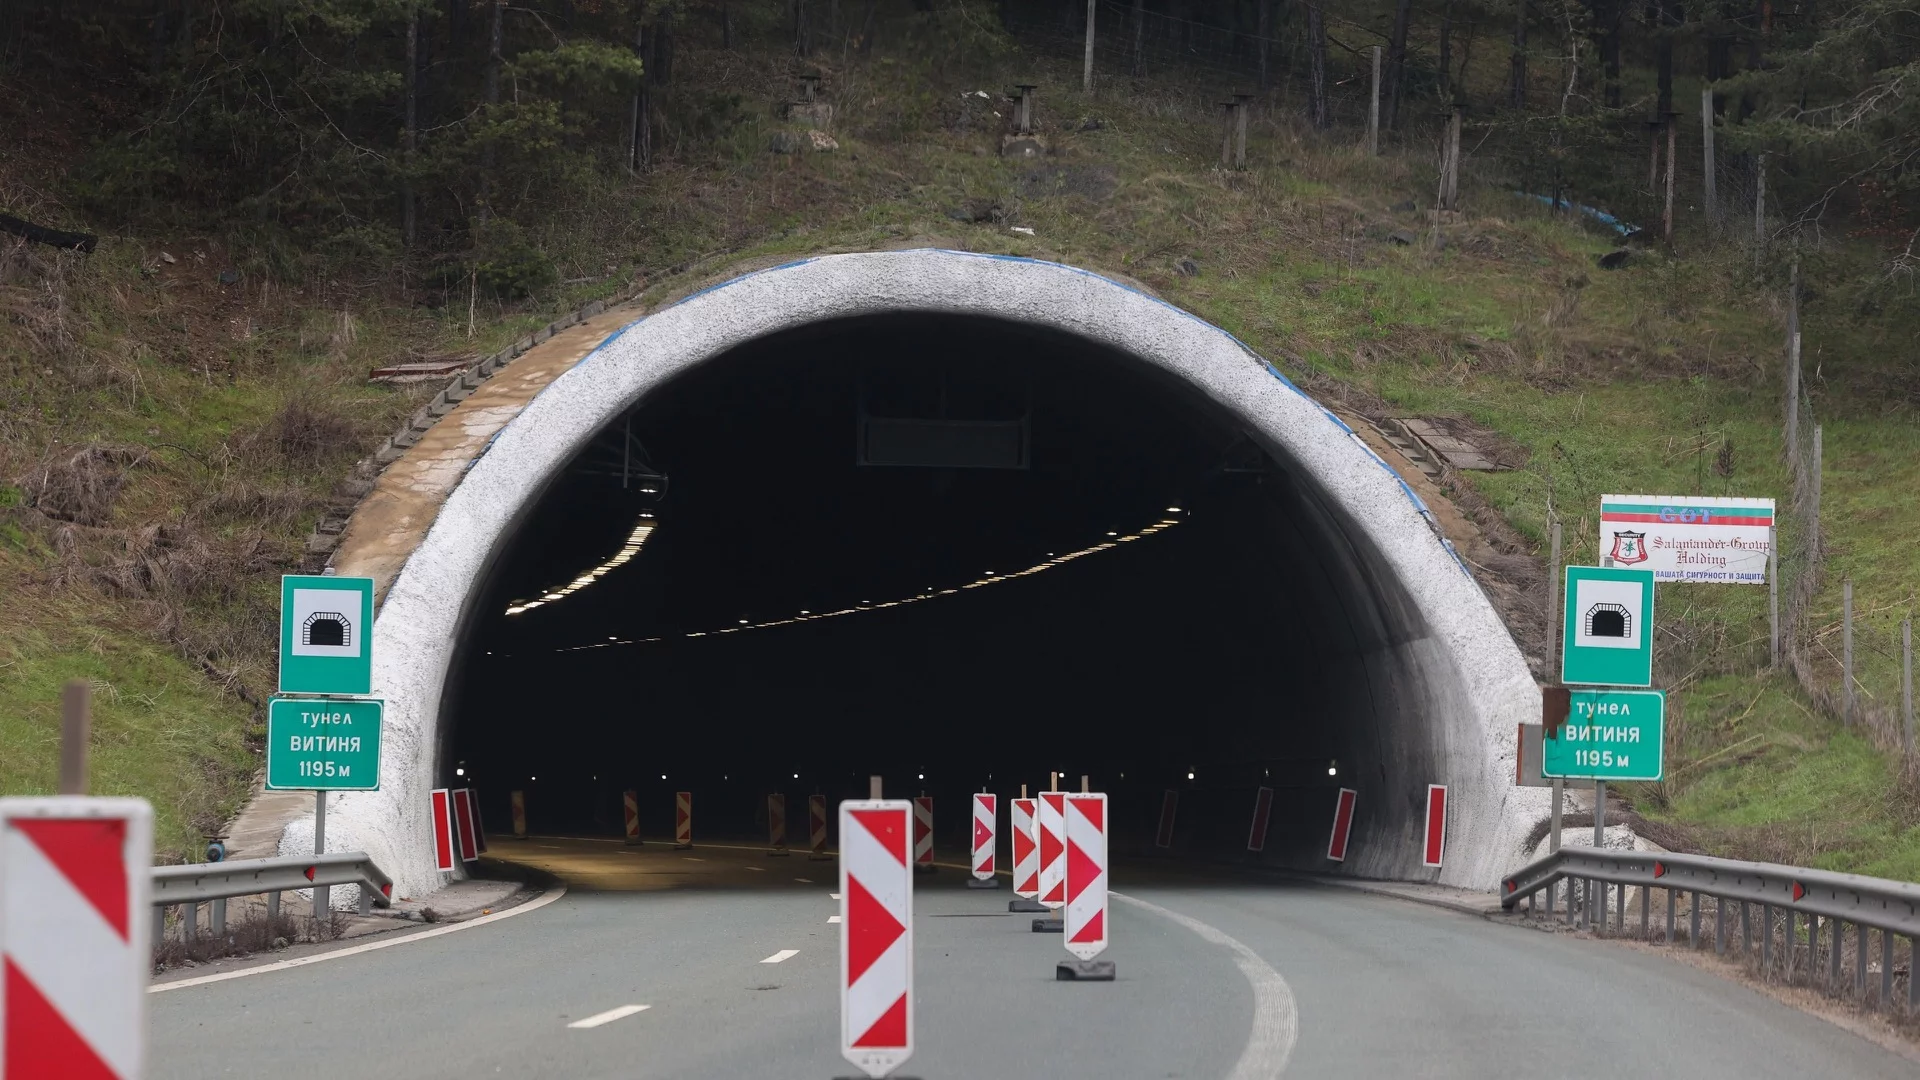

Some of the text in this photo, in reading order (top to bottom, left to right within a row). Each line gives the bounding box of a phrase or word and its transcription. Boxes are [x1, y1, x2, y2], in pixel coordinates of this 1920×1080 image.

[1676, 550, 1727, 568] Holding
[1686, 571, 1726, 580] СИГУРНОСТ
[1728, 572, 1734, 580] И
[1735, 572, 1765, 581] ЗАЩИТА
[1576, 702, 1630, 719] тунел
[301, 712, 352, 728] тунел
[1565, 724, 1640, 743] ВИТИНЯ
[290, 735, 361, 753] ВИТИНЯ
[1575, 749, 1629, 768] 1195 м
[299, 760, 351, 777] 1195 м
